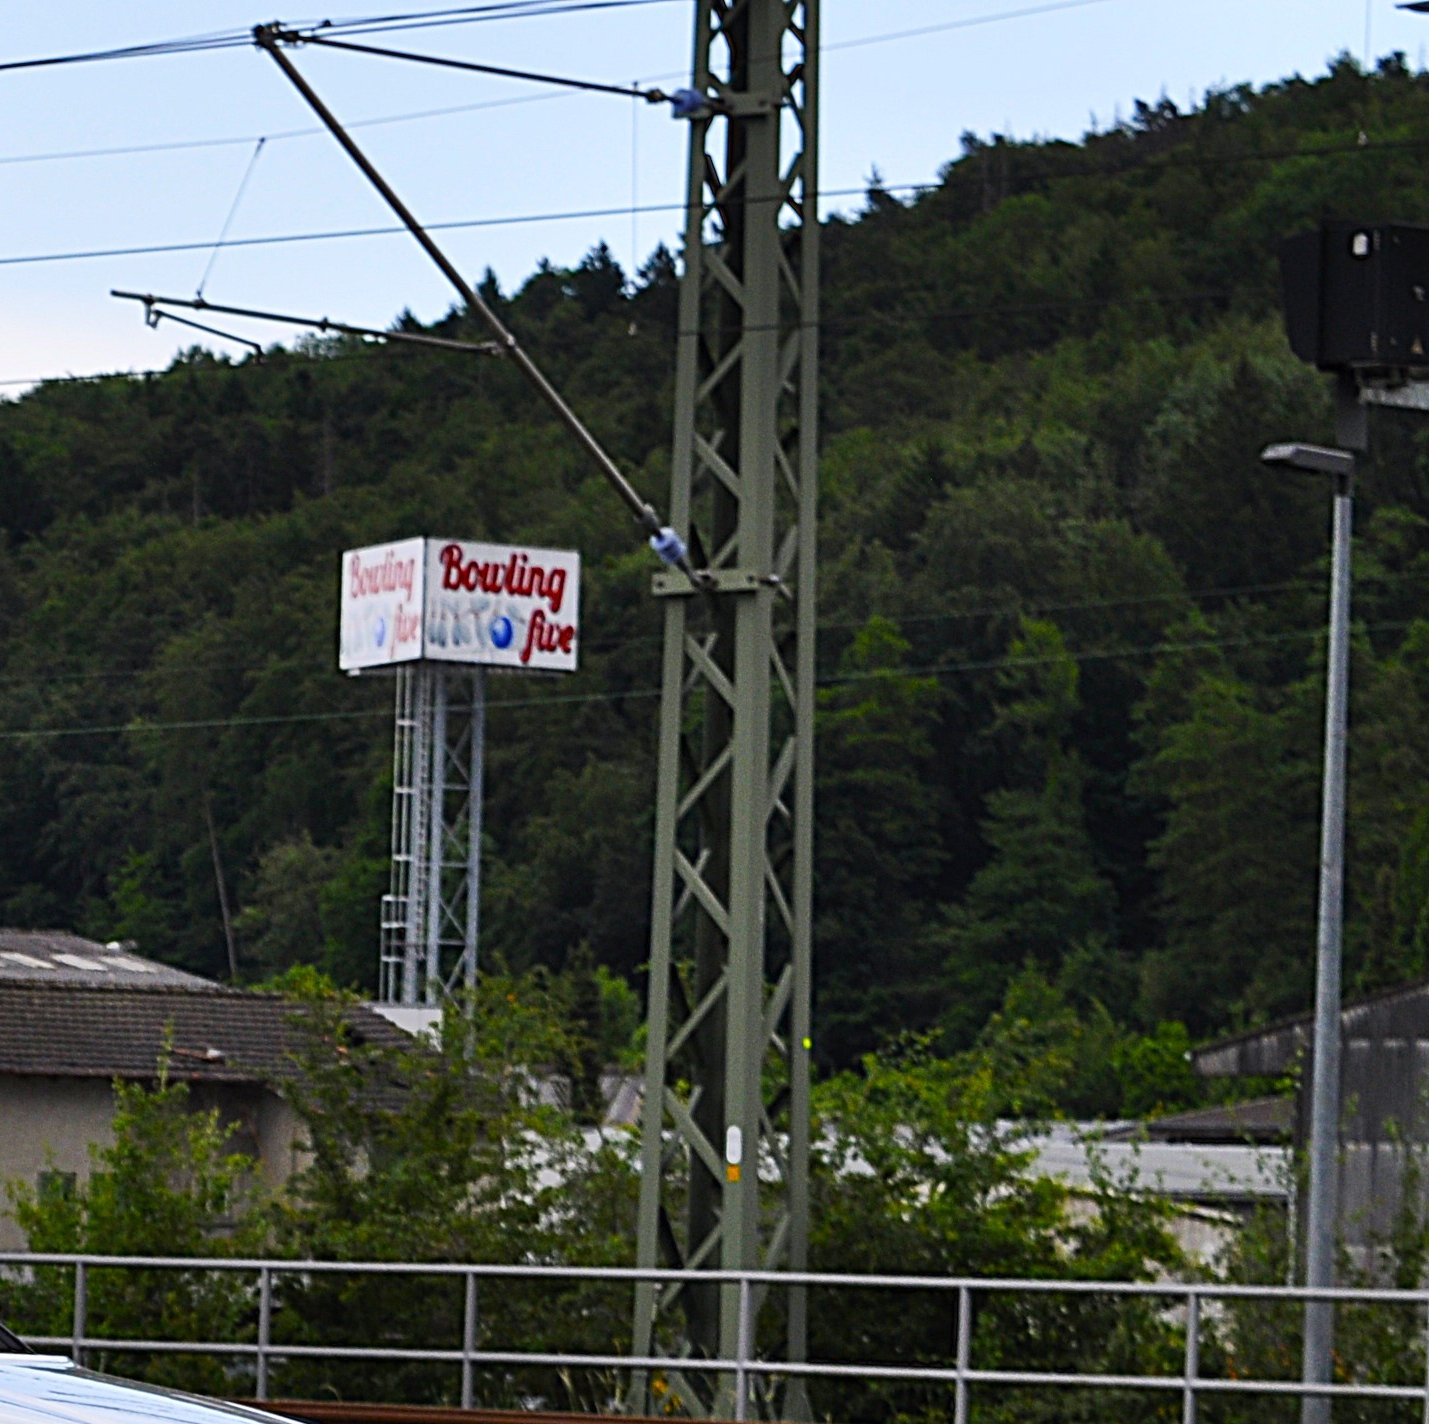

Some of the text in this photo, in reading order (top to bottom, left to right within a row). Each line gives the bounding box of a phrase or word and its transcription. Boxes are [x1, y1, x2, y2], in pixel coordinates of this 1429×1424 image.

[350, 550, 415, 602] Bowling
[440, 543, 567, 613] Bowling
[519, 608, 576, 664] five
